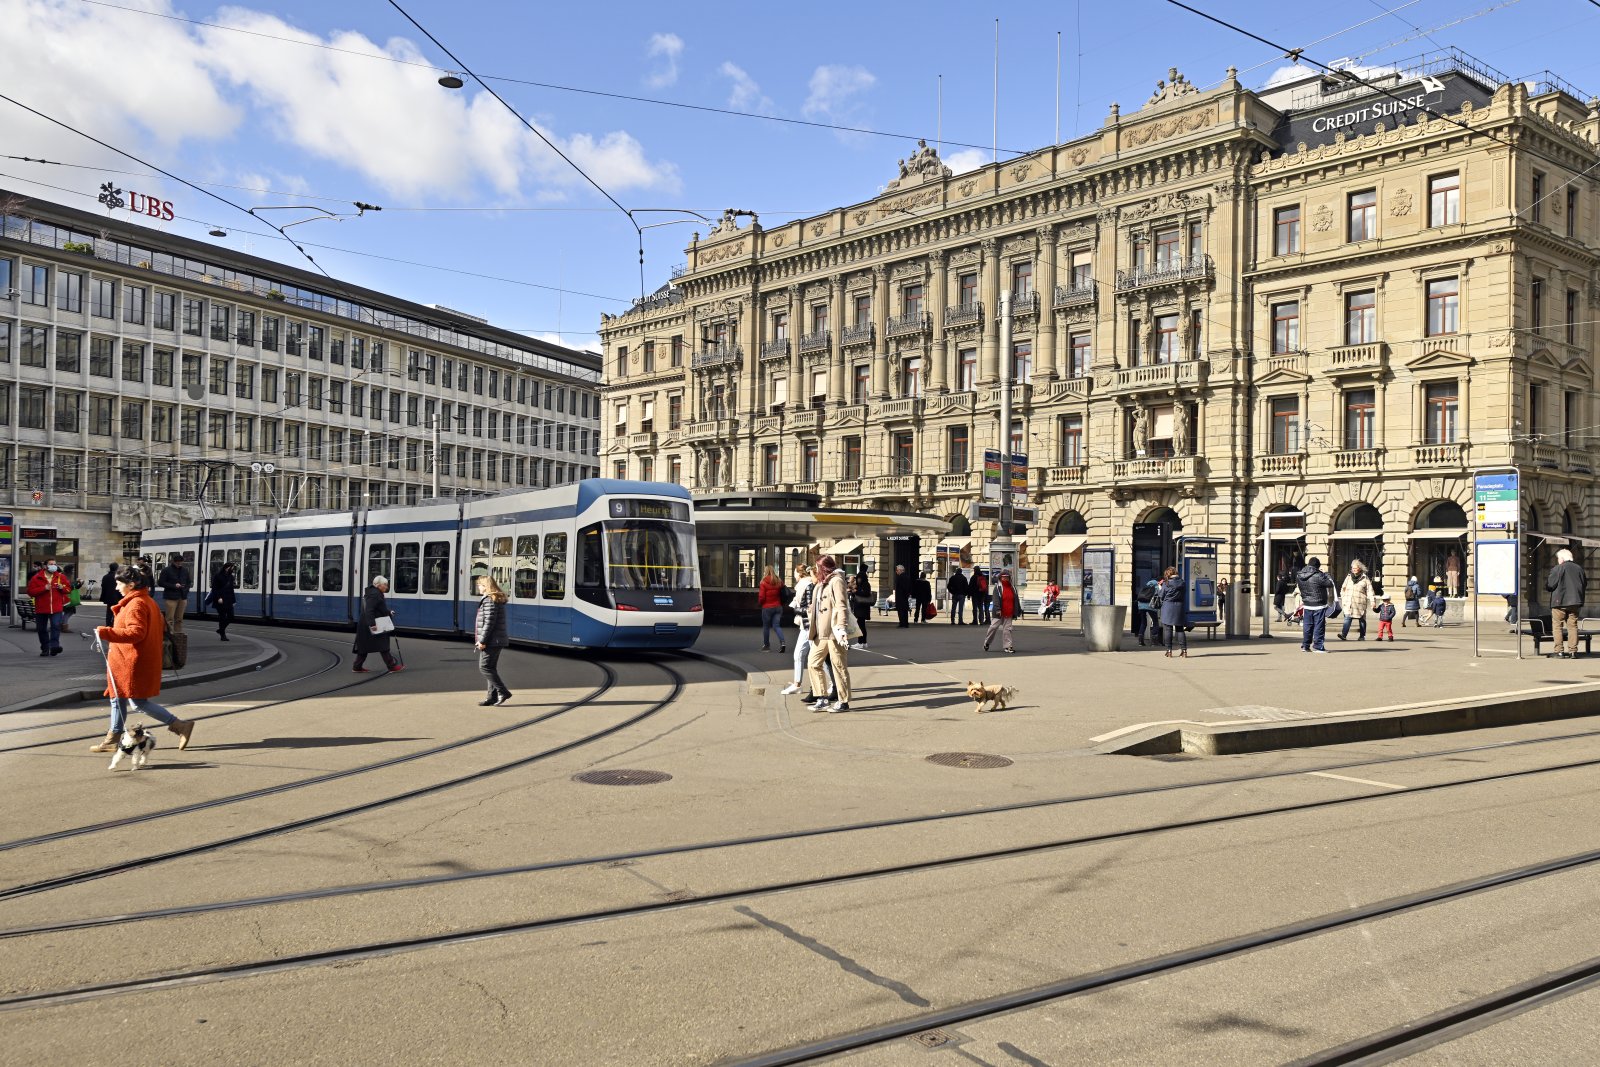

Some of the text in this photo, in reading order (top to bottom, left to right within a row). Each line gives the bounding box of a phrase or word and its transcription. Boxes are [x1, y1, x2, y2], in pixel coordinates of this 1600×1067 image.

[1312, 94, 1425, 133] CREDIT SUISSE
[129, 191, 175, 221] UBS
[615, 503, 623, 513] 9
